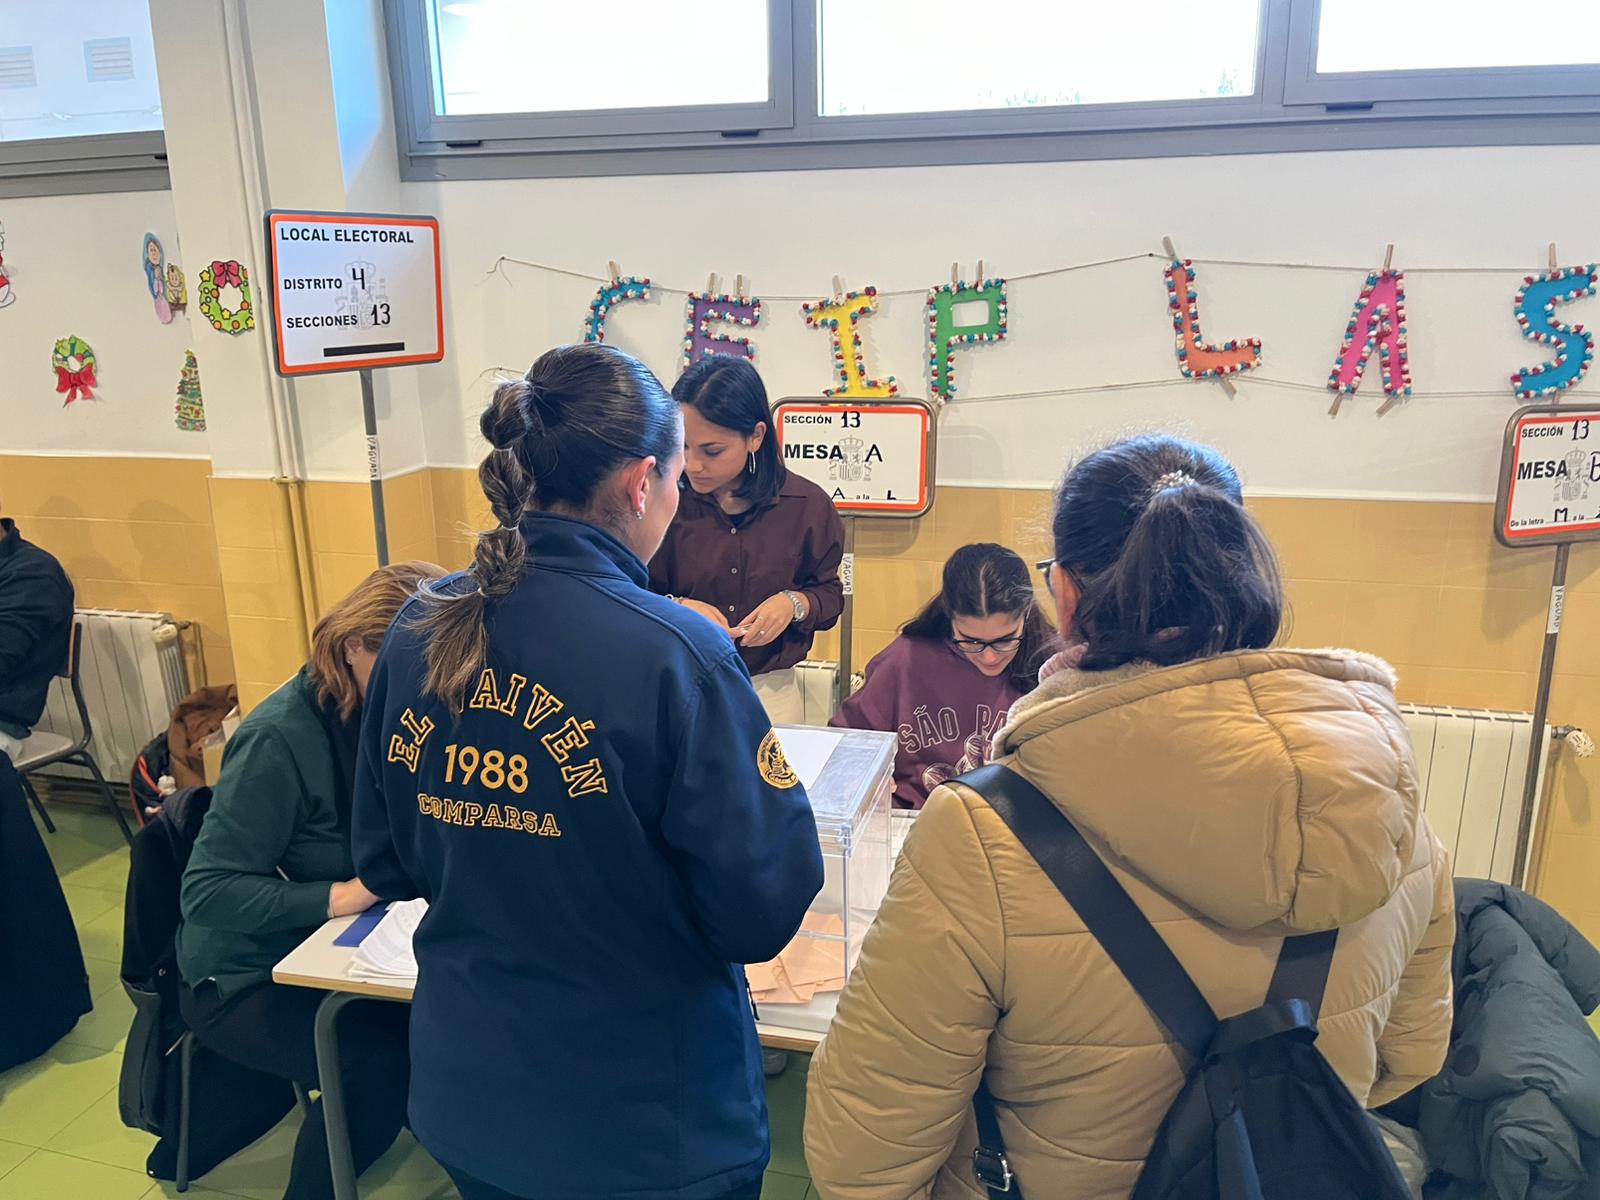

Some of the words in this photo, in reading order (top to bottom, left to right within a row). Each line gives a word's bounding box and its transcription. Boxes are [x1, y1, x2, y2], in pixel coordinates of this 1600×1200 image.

[281, 228, 330, 241] LOCAL
[334, 229, 414, 243] ELECTORAL
[284, 278, 342, 290] DISTRITO
[352, 267, 366, 290] 4
[286, 315, 358, 328] SECCIONES
[371, 303, 391, 326] 13
[1163, 258, 1600, 400] LAS
[784, 414, 832, 424] SECCIÓN
[841, 410, 861, 429] 13
[1521, 425, 1564, 438] SECCIÓN
[1572, 418, 1590, 441] 13
[784, 443, 843, 459] MESA
[865, 443, 883, 463] A
[1517, 460, 1568, 480] MESA
[831, 487, 846, 500] A
[1528, 518, 1544, 526] letra
[1554, 507, 1568, 523] M
[387, 707, 436, 773] EL
[457, 668, 609, 799] AIVÉN
[897, 704, 961, 753] SÃO
[975, 704, 1008, 742] PA
[444, 743, 529, 794] 1988
[417, 792, 562, 836] COMPARSA
